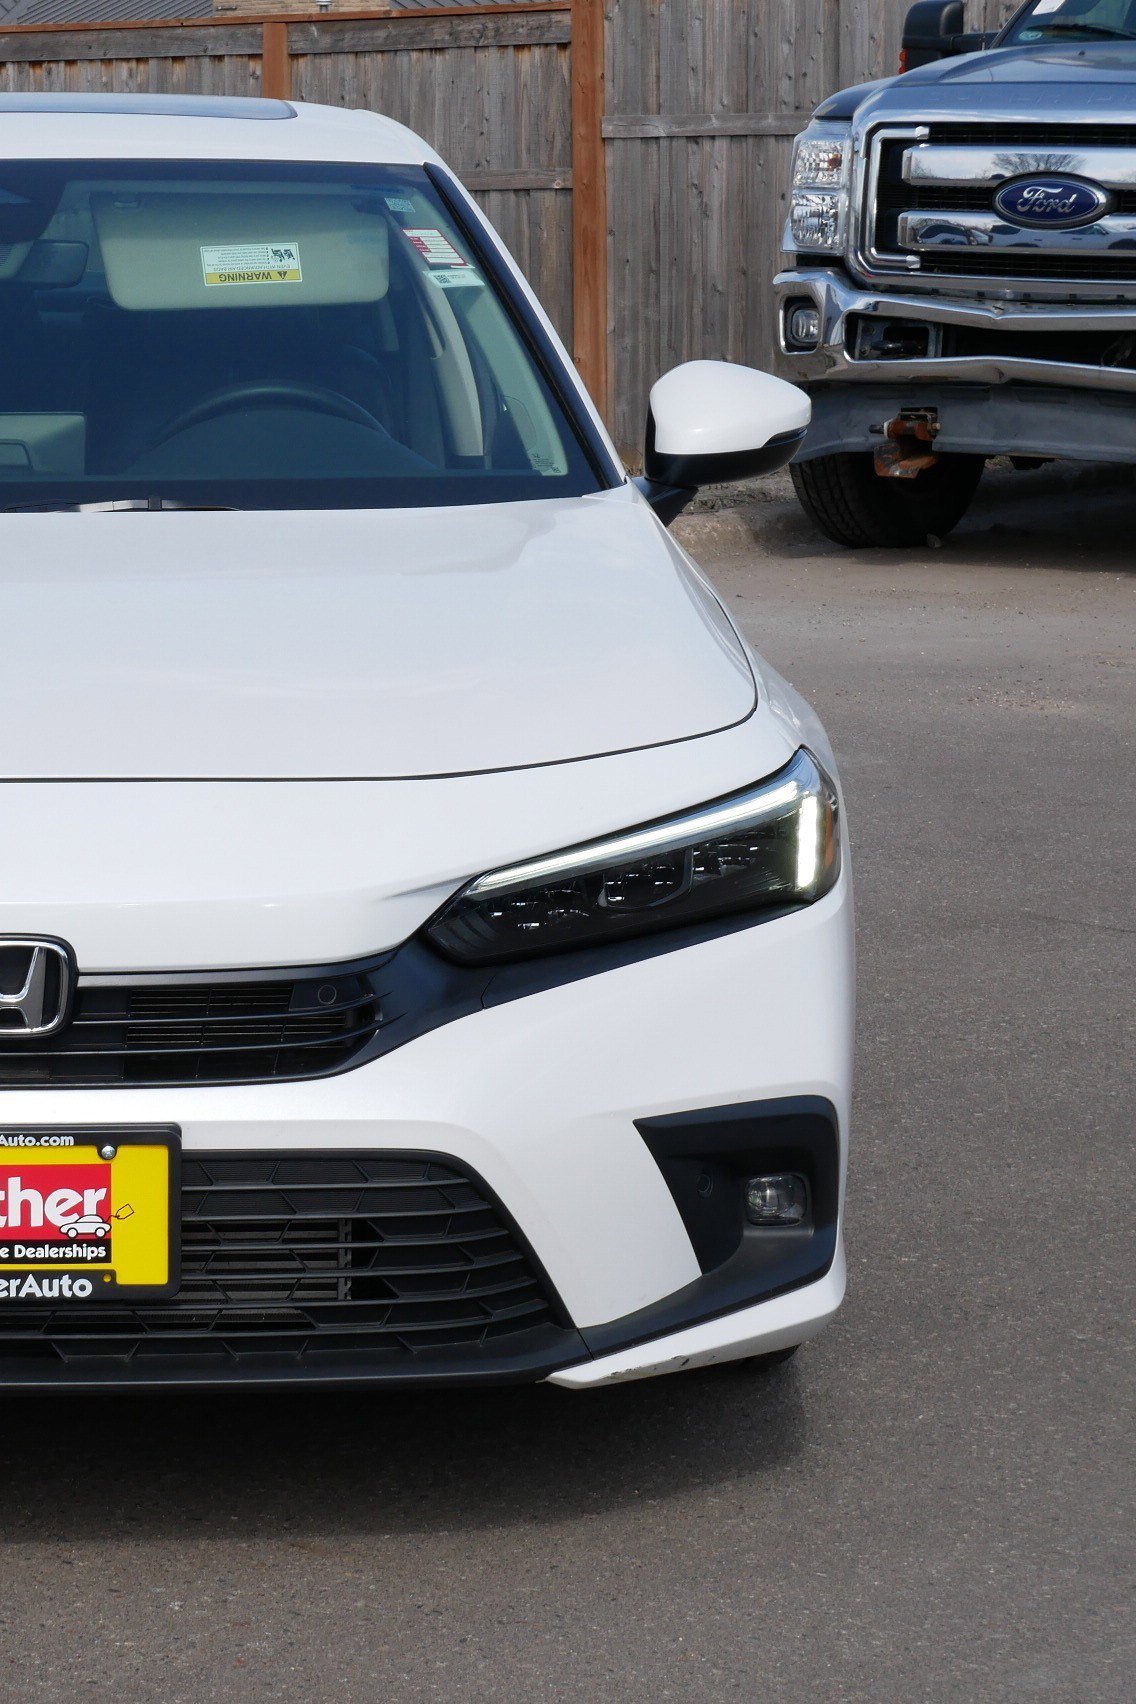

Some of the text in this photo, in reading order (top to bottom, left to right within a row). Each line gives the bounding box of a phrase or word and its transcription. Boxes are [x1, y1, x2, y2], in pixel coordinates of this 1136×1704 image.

[1016, 186, 1078, 214] Ford
[218, 271, 272, 282] WARNING
[13, 1244, 107, 1261] Dealerships
